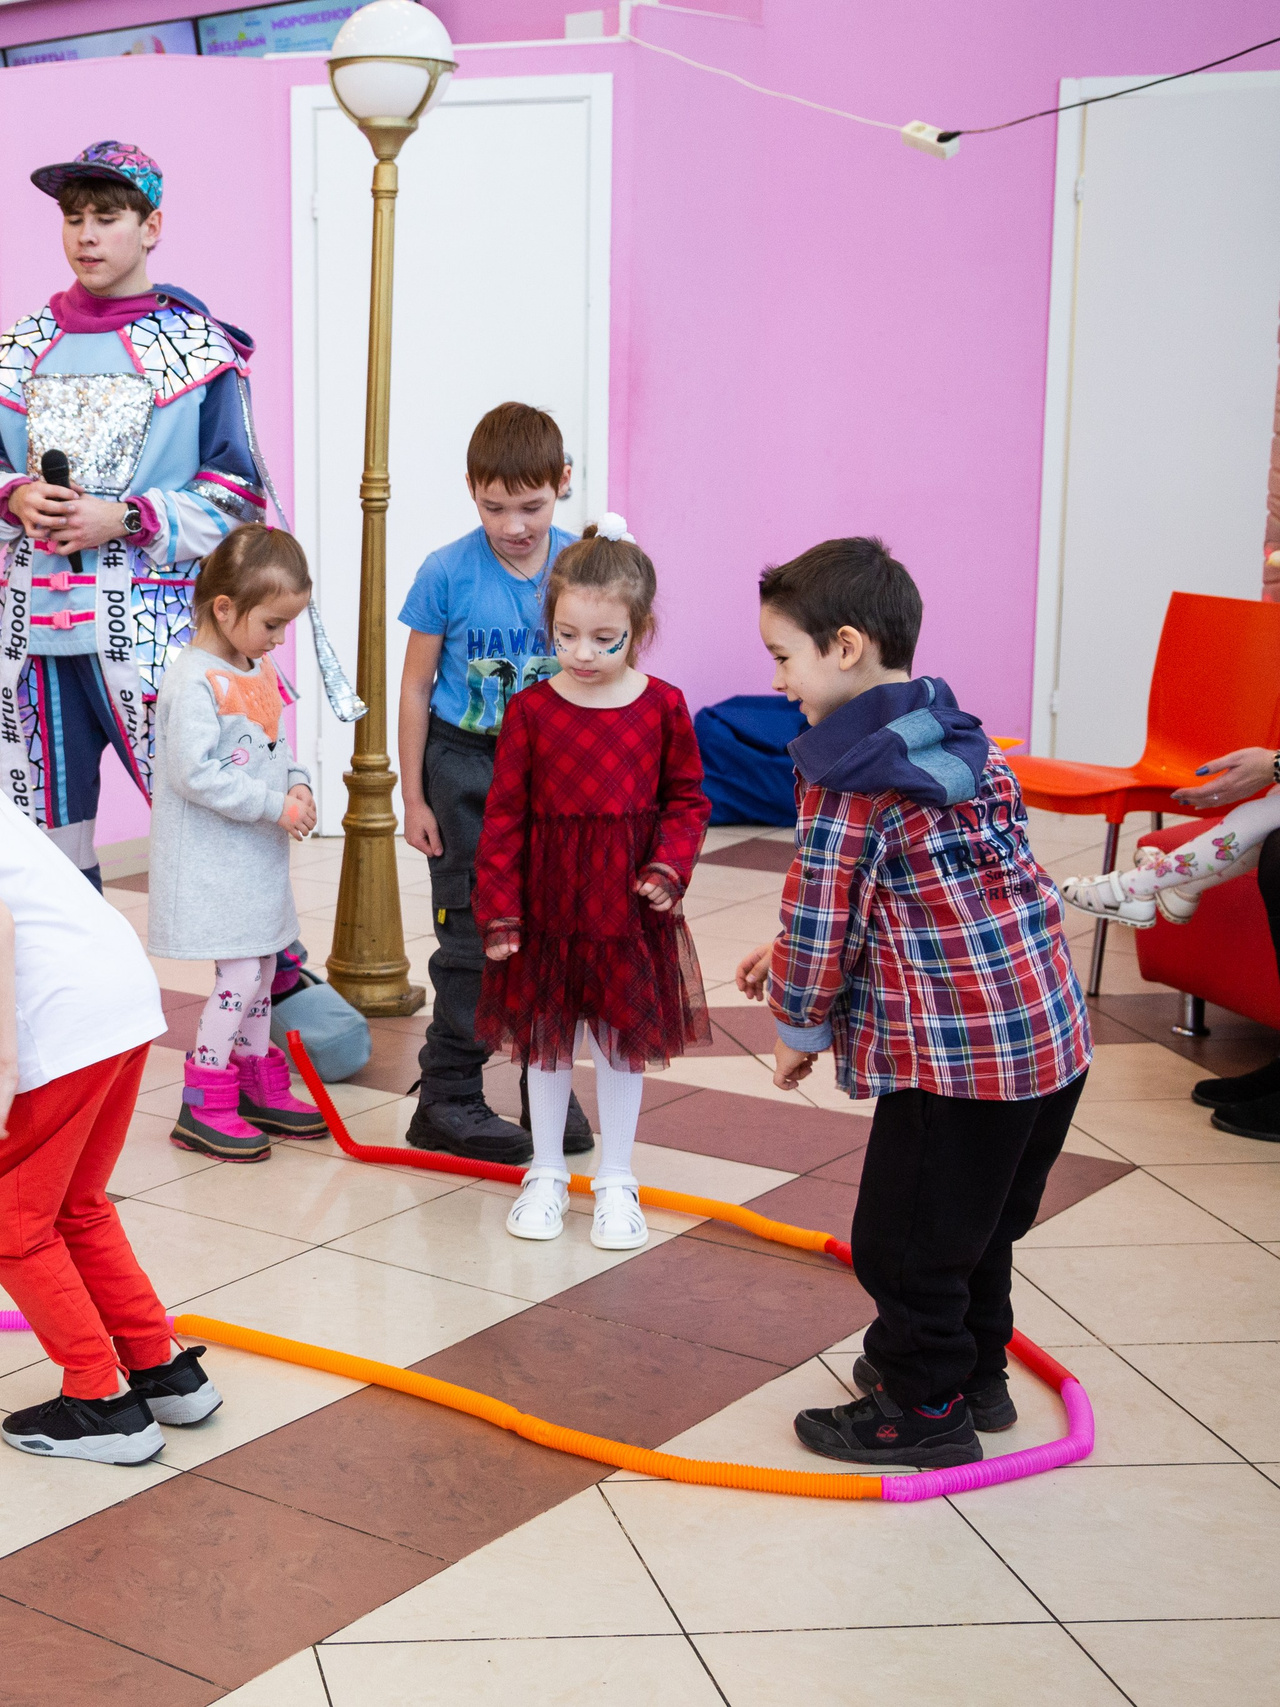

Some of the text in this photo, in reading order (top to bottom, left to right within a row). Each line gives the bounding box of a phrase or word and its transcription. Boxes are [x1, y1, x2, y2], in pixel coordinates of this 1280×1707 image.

[5, 588, 28, 661] #good
[102, 589, 133, 663] #good
[467, 627, 557, 662] HAWA
[1, 686, 21, 744] #true
